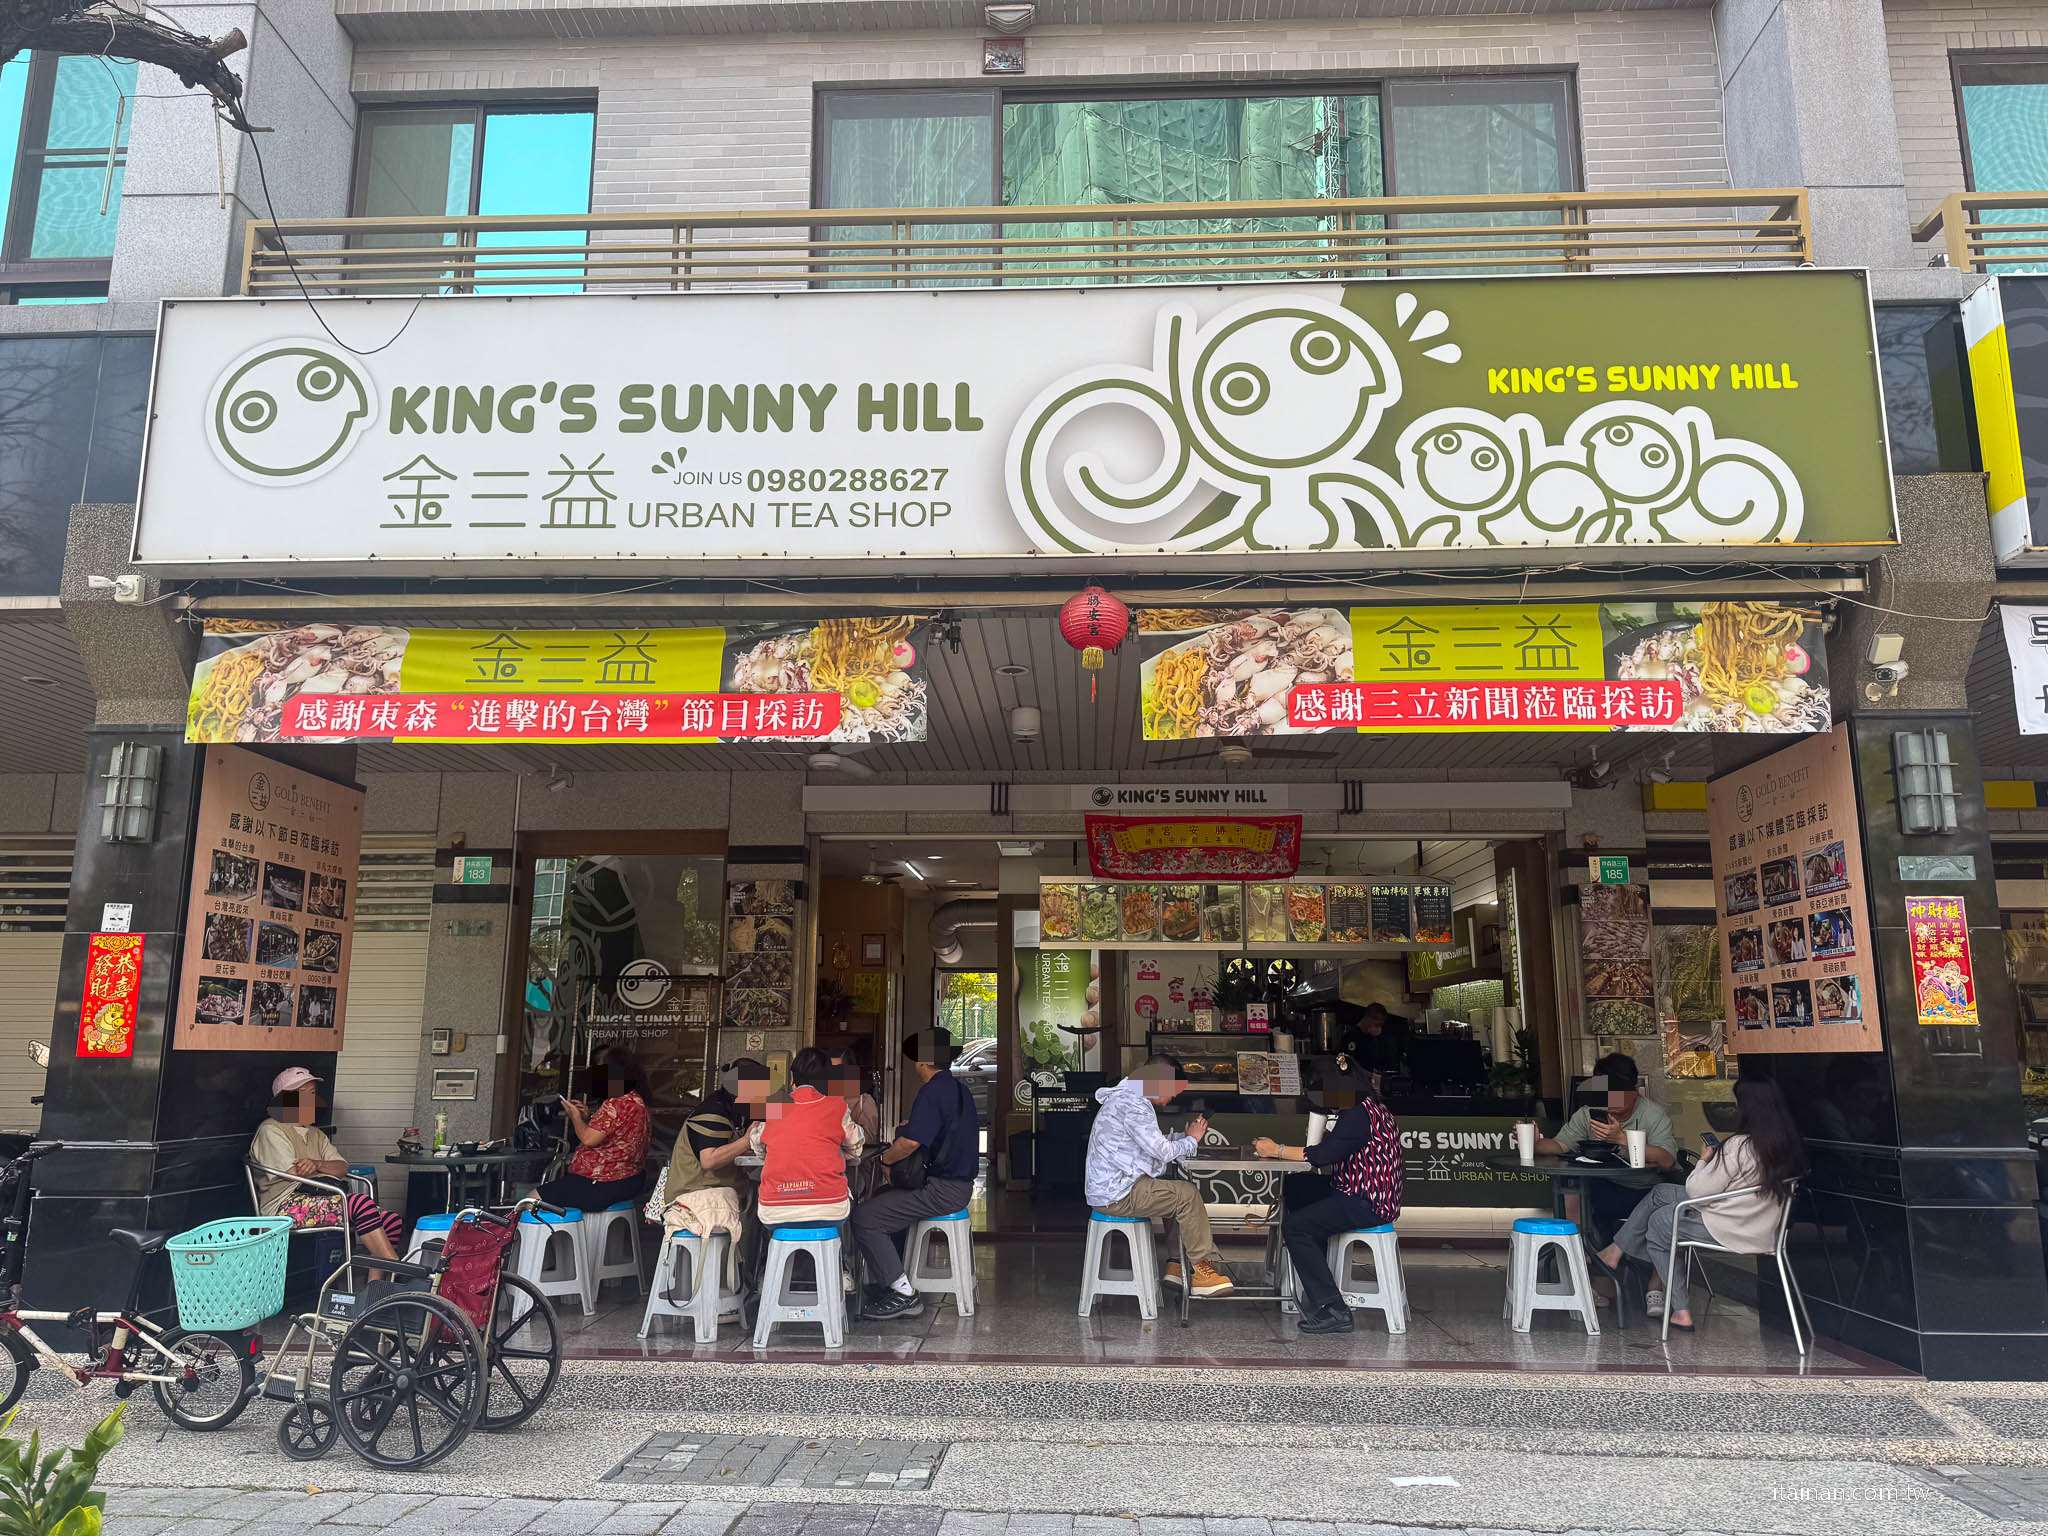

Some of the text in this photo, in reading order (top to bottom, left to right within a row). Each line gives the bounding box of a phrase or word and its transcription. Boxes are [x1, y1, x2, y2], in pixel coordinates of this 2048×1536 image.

[1486, 362, 1799, 394] KING'S SUNNY HILL
[390, 381, 984, 434] KING'S SUNNY HILL
[380, 453, 618, 529] 金三益
[673, 467, 950, 493] JOIN US 0980288627
[628, 501, 953, 529] URBAN TEA SHOP
[1377, 614, 1580, 673] 金三益
[465, 632, 658, 686] 金三益
[1292, 686, 1674, 722] 感謝三立新聞蒞臨採訪
[1117, 788, 1267, 804] KING'S SUNNY HILL
[1755, 766, 1809, 799] GOLD BENEFIT
[274, 785, 332, 814] GOLD BENEFIT
[229, 812, 342, 857] 感謝以下節目蒞臨採訪
[468, 869, 485, 880] 183
[1606, 869, 1623, 879] 185
[1041, 953, 1051, 988] URBAN
[1042, 990, 1051, 1009] TEA
[584, 1029, 669, 1039] URBAN TEA SHOP
[1437, 1131, 1504, 1150] SUNNY
[1453, 1172, 1493, 1182] URBAN
[1498, 1172, 1518, 1181] TEA
